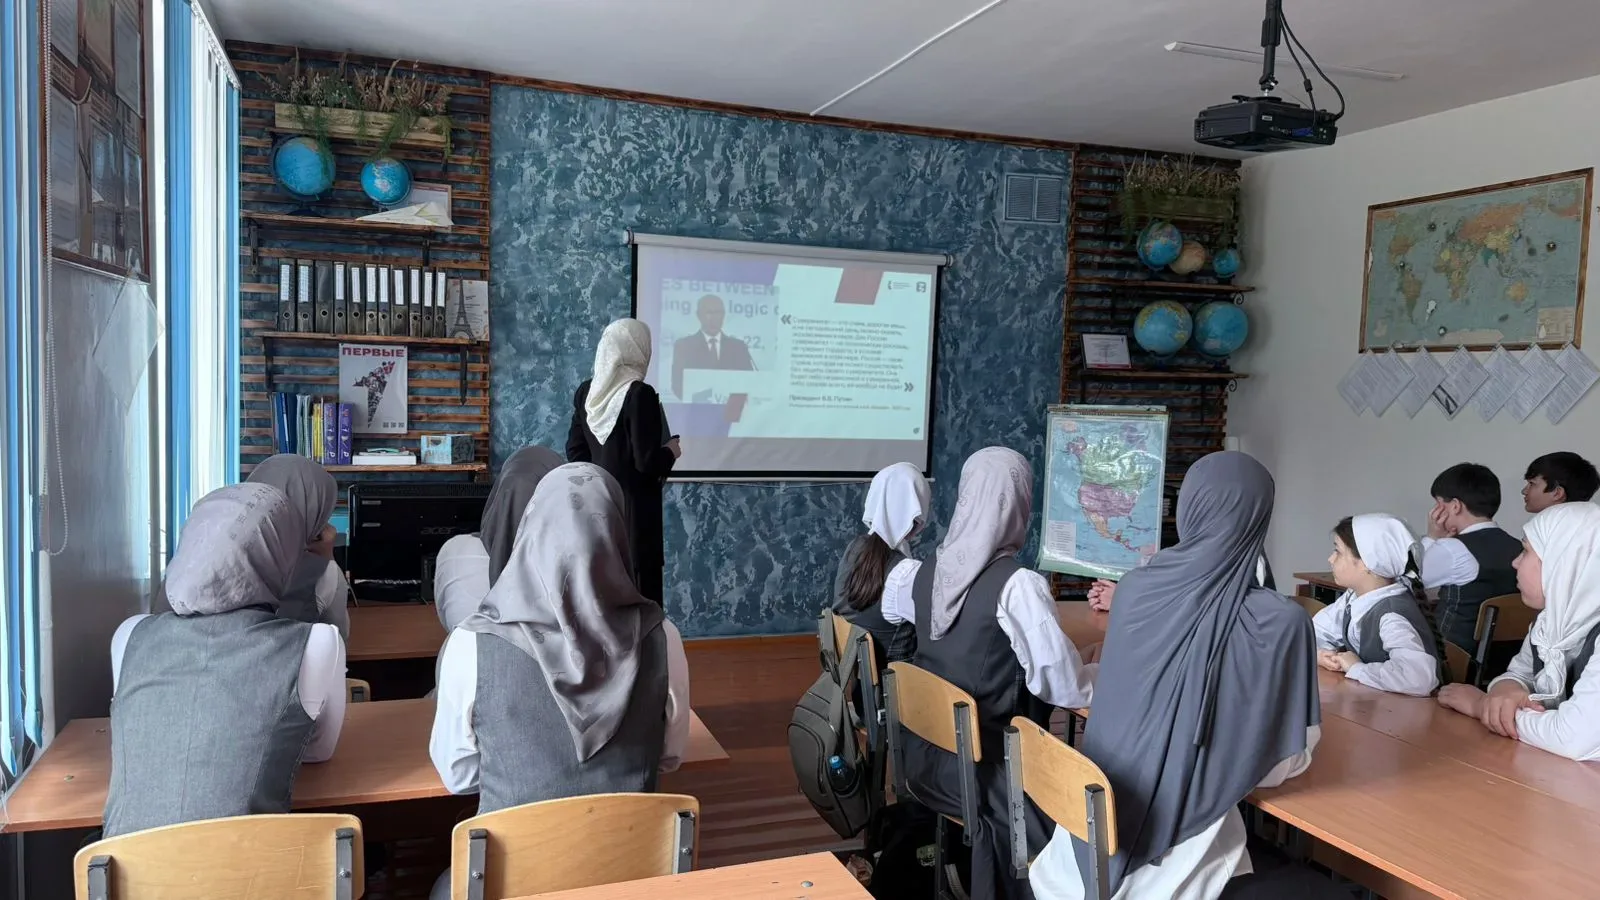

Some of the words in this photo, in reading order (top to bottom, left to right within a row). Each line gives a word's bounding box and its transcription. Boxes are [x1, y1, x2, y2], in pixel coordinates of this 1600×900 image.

[728, 299, 769, 318] logic
[342, 346, 405, 358] ПЕРВЫЕ
[420, 526, 457, 535] acer
